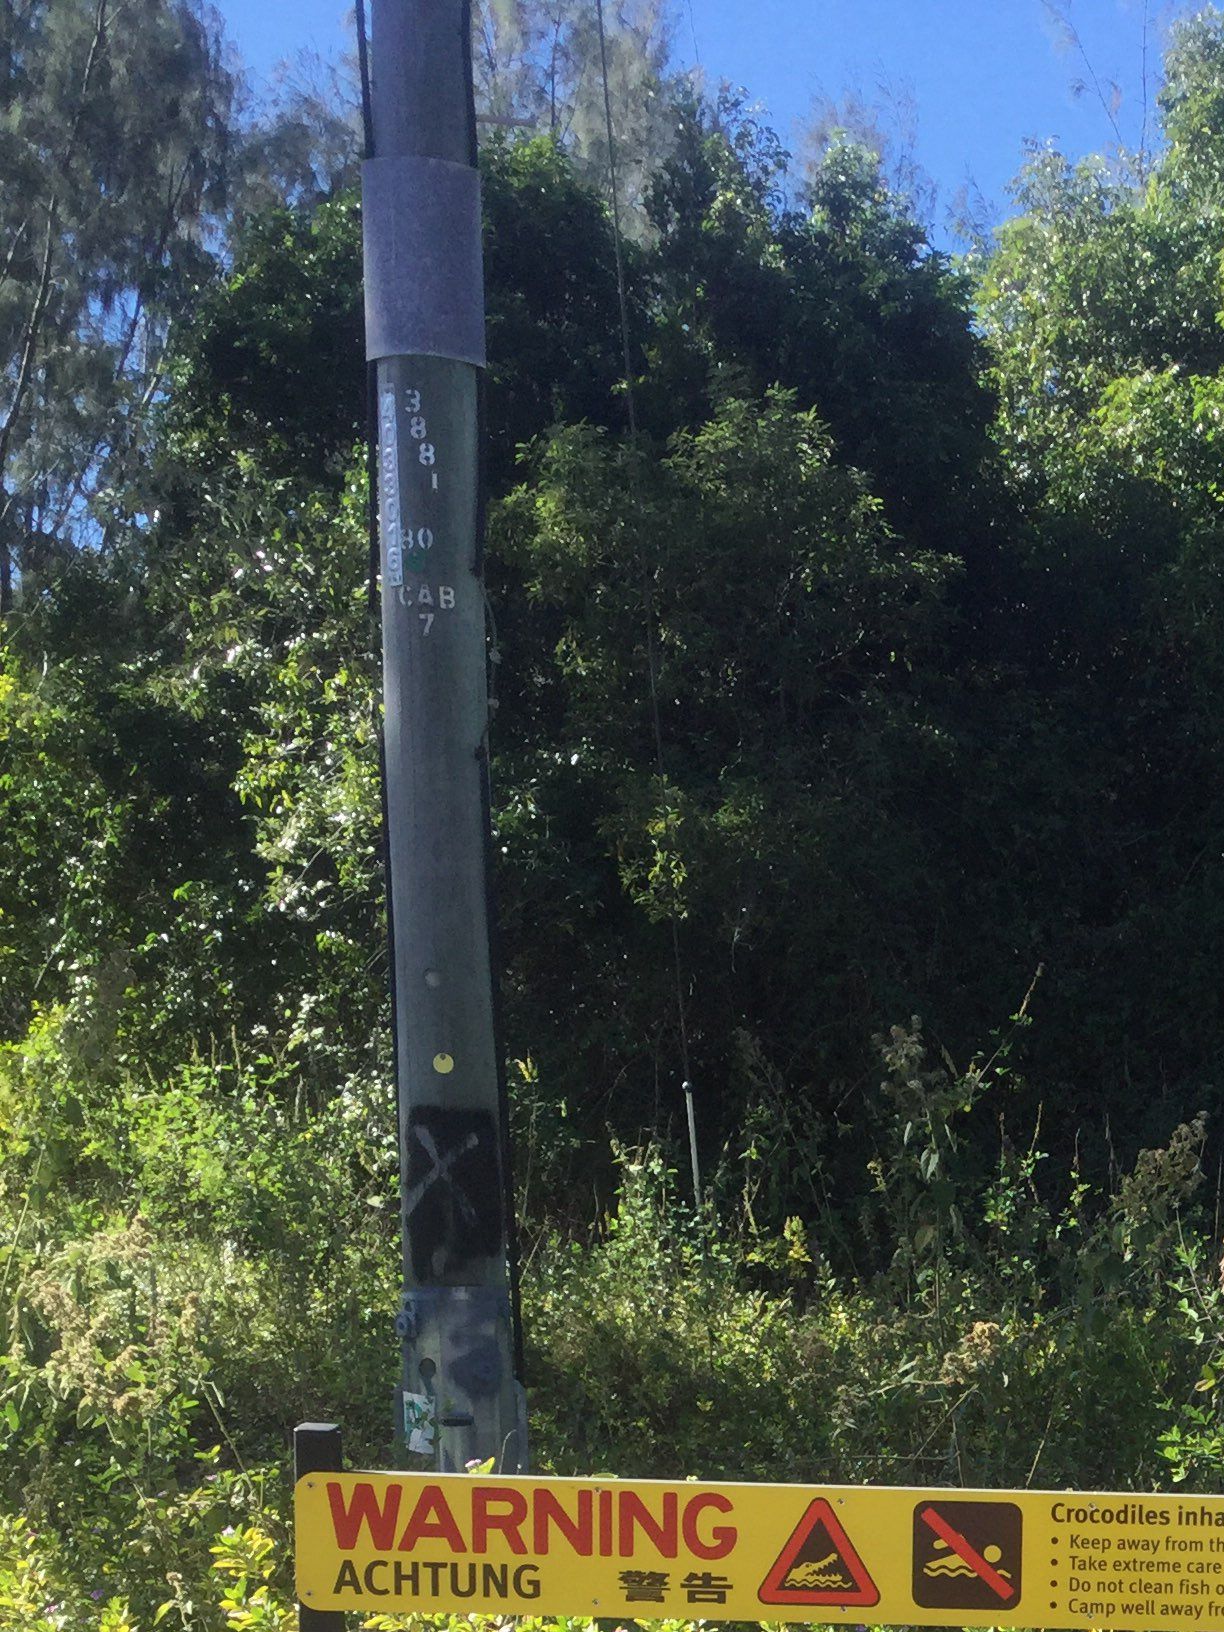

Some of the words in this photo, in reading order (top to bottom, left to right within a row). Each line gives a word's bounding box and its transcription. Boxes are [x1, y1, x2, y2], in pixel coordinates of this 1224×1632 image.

[418, 613, 435, 636] 7
[326, 1482, 738, 1561] WARNING
[1050, 1502, 1170, 1526] Crocodiles
[1069, 1534, 1112, 1553] Keep
[1116, 1538, 1160, 1555] away
[1164, 1536, 1204, 1553] from
[1069, 1556, 1107, 1571] Take
[1112, 1558, 1182, 1574] extreme
[1186, 1562, 1222, 1575] care
[333, 1559, 541, 1599] ACHTUNG
[618, 1570, 734, 1604] 警告
[1068, 1577, 1092, 1593] Do
[1096, 1580, 1124, 1594] not
[1129, 1579, 1174, 1595] clean
[1179, 1580, 1211, 1596] fish
[1068, 1598, 1116, 1617] Camp
[1121, 1600, 1156, 1616] well
[1160, 1603, 1203, 1620] away
